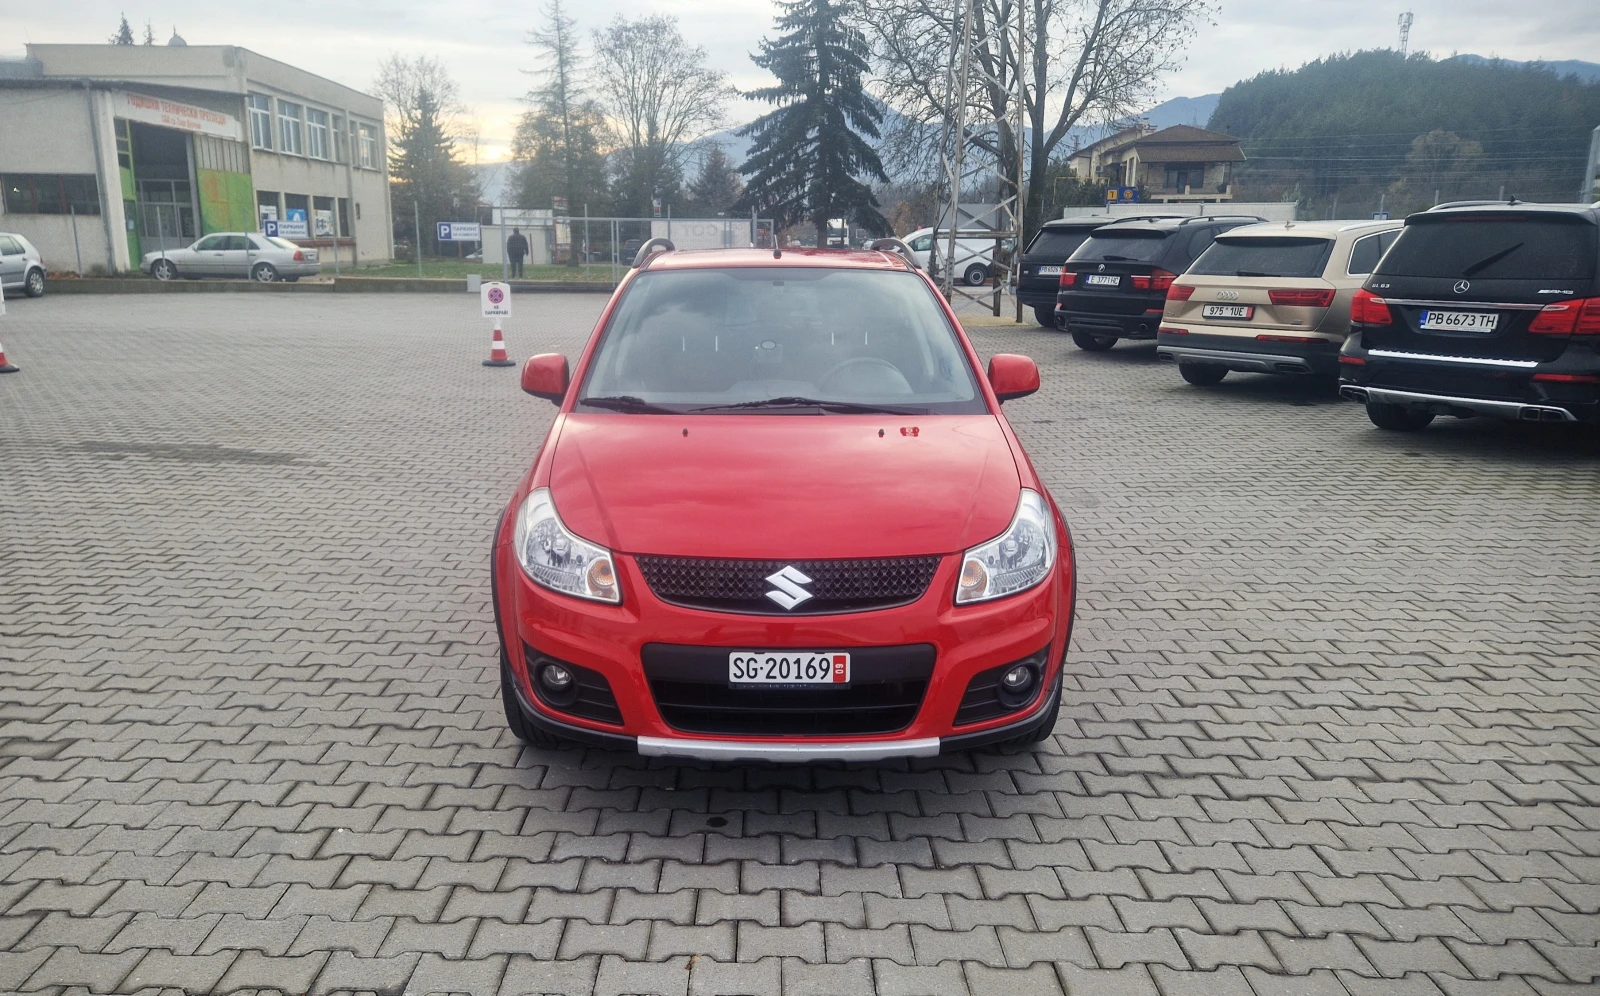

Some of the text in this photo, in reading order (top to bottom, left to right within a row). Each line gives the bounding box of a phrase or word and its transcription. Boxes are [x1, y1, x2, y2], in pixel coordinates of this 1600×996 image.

[268, 223, 276, 234] P
[441, 226, 450, 237] P
[1209, 306, 1224, 316] 975
[1427, 312, 1496, 328] PB 6673 TH
